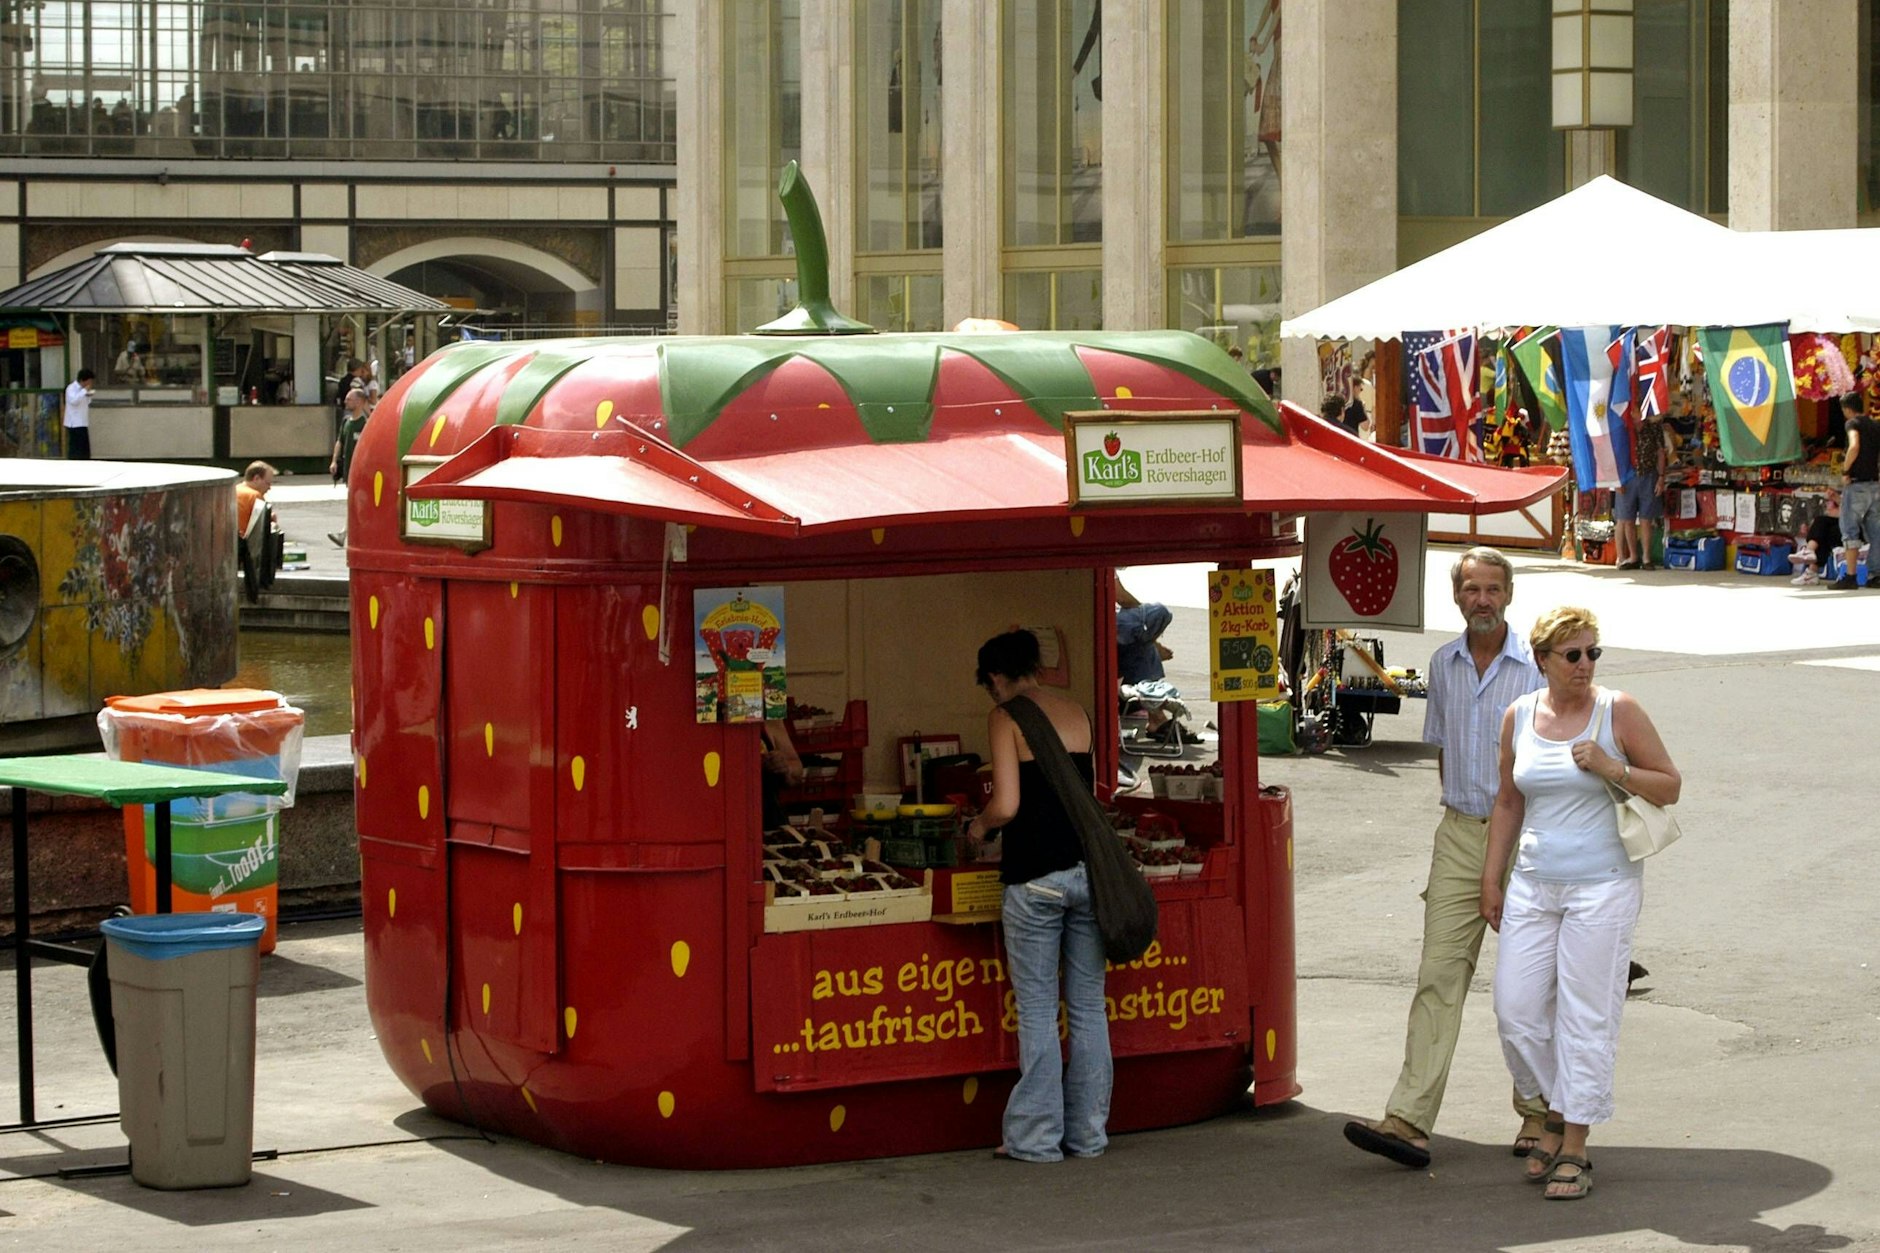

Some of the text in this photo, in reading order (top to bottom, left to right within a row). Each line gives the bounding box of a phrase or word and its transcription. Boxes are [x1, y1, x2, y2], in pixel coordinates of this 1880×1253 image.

[1146, 447, 1226, 464] Erdbeer-Hof
[1087, 454, 1139, 481] Karl's
[1147, 467, 1227, 486] Rövershagen
[1223, 602, 1264, 617] Aktion
[1220, 618, 1270, 637] 2kg-Korb
[807, 907, 888, 922] Karl's Erdbeer-Hof
[812, 966, 885, 1001] aus
[773, 1000, 984, 1055] ...taufrisch
